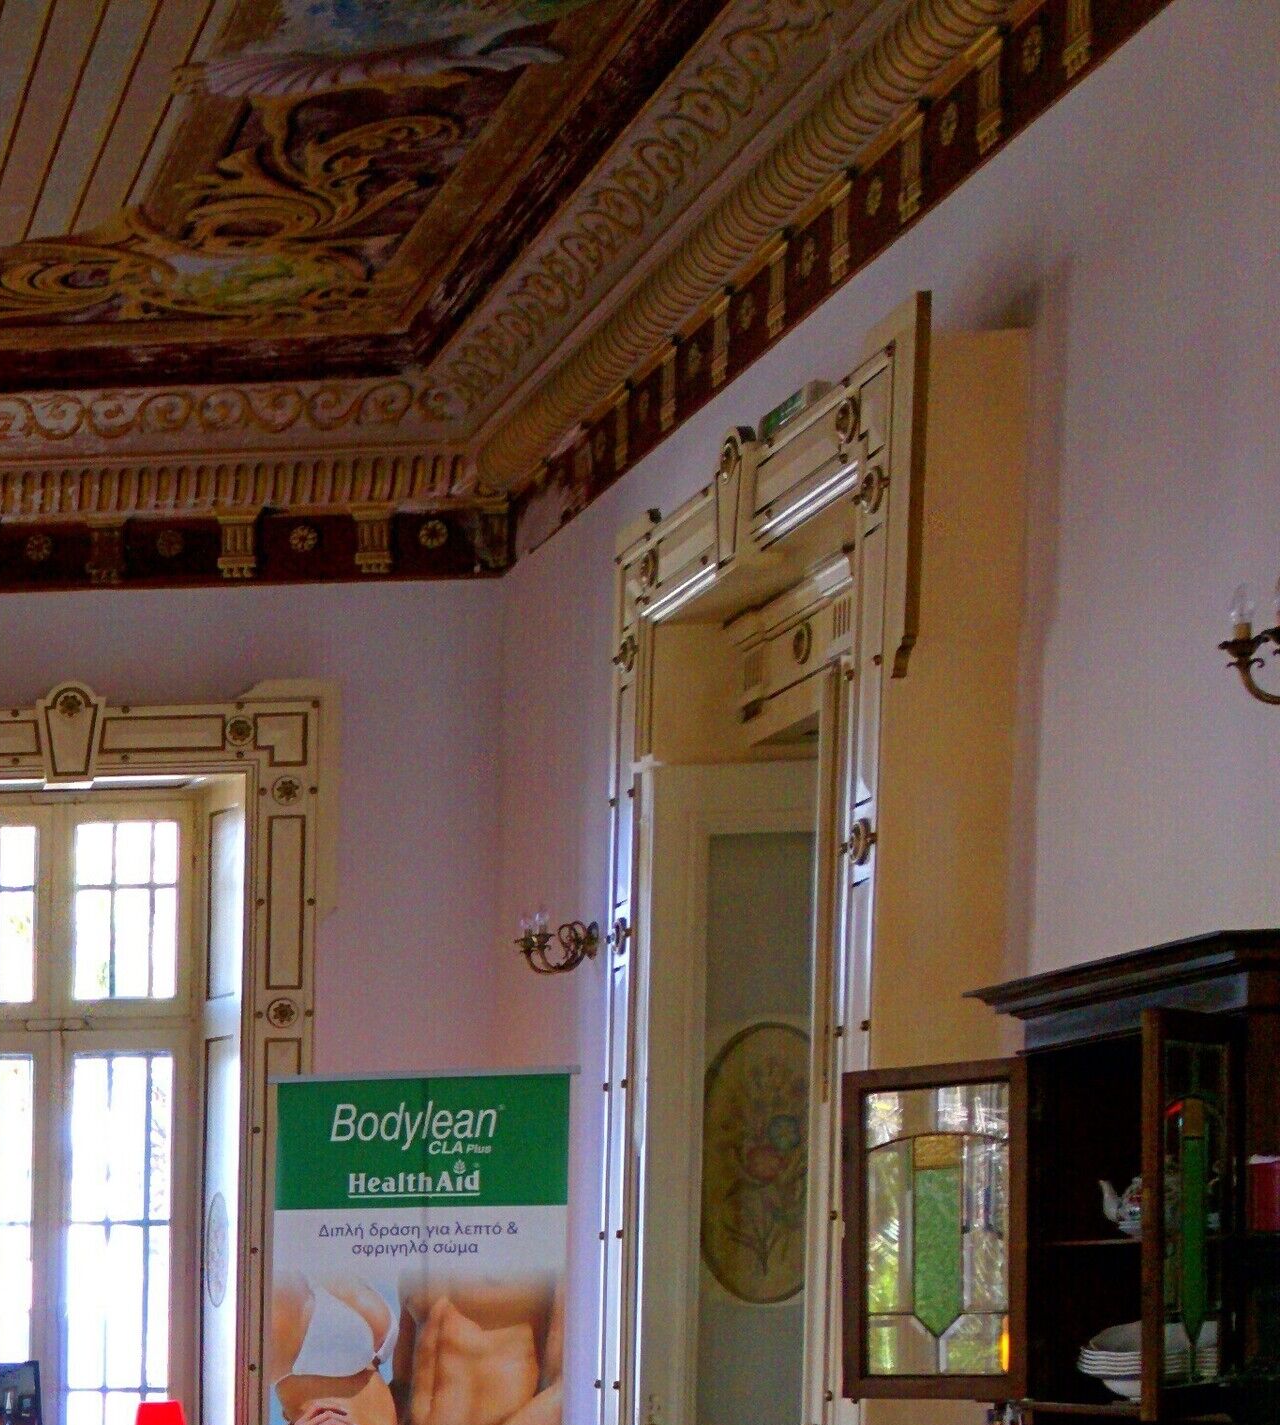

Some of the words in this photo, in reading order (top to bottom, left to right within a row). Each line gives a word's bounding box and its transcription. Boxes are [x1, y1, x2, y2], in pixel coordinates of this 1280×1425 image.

[330, 1100, 497, 1150] Bodylean
[428, 1141, 464, 1155] CLA
[466, 1143, 492, 1154] Plus
[318, 1223, 364, 1239] Διπλή
[369, 1223, 421, 1239] δράση
[426, 1225, 450, 1238] για
[454, 1221, 502, 1236] λεπτό
[506, 1221, 519, 1235] &
[352, 1240, 429, 1257] σφριγηλό
[433, 1240, 479, 1256] σώμα
